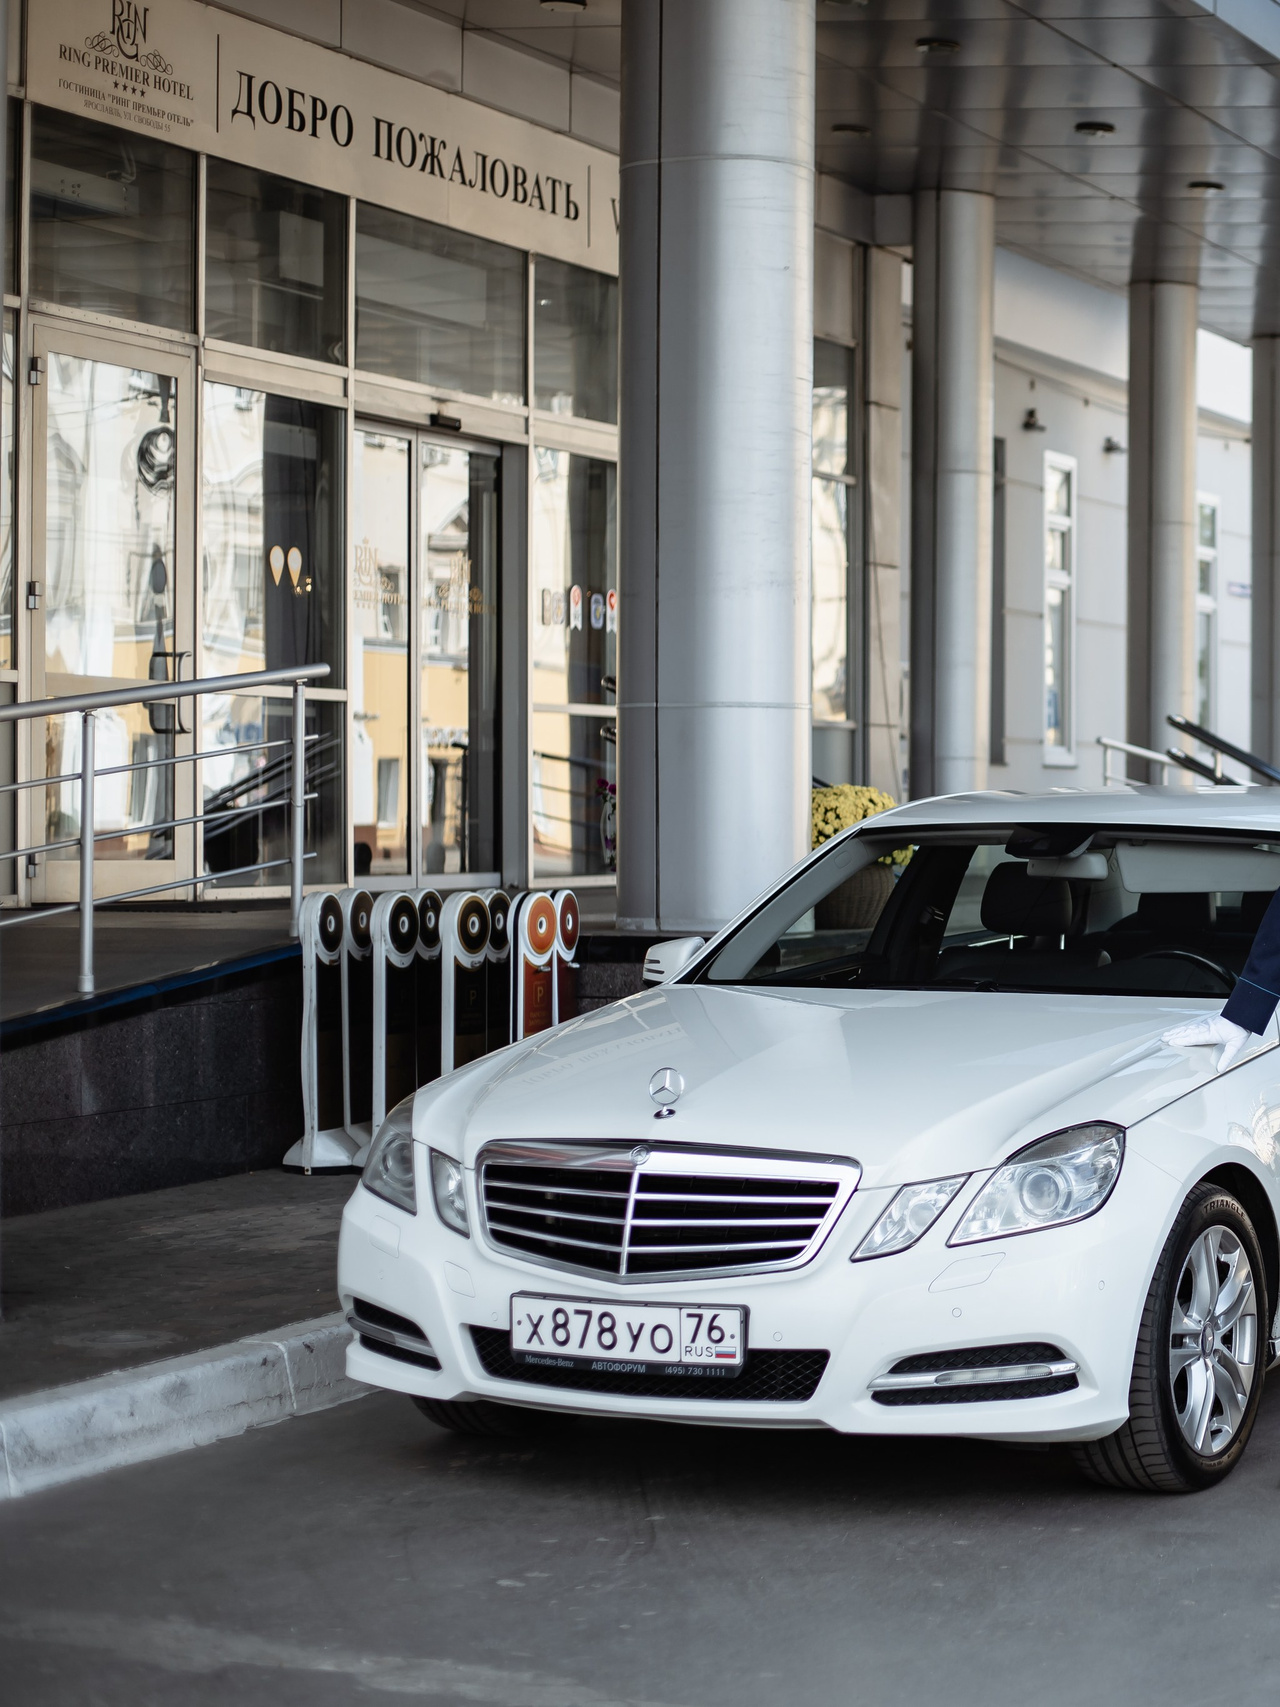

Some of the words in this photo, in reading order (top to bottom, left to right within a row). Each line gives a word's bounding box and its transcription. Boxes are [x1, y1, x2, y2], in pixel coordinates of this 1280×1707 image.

[58, 43, 91, 68] RING
[94, 55, 150, 87] PREMIER
[153, 74, 194, 101] HOTEL
[58, 78, 106, 101] ГОСТИНИЦА
[132, 101, 166, 120] ПРЕМЬЕР
[164, 123, 171, 133] 55
[231, 70, 354, 148] ДОБРО
[372, 116, 580, 221] ПОЖАЛОВАТЬ
[686, 1313, 726, 1344] 76
[685, 1345, 714, 1358] RUS
[525, 1354, 575, 1368] Mercedes-Benz
[591, 1361, 646, 1374] АВТОФОРУМ
[664, 1366, 686, 1375] (495)
[687, 1367, 703, 1376] 730
[705, 1368, 726, 1376] 1111
